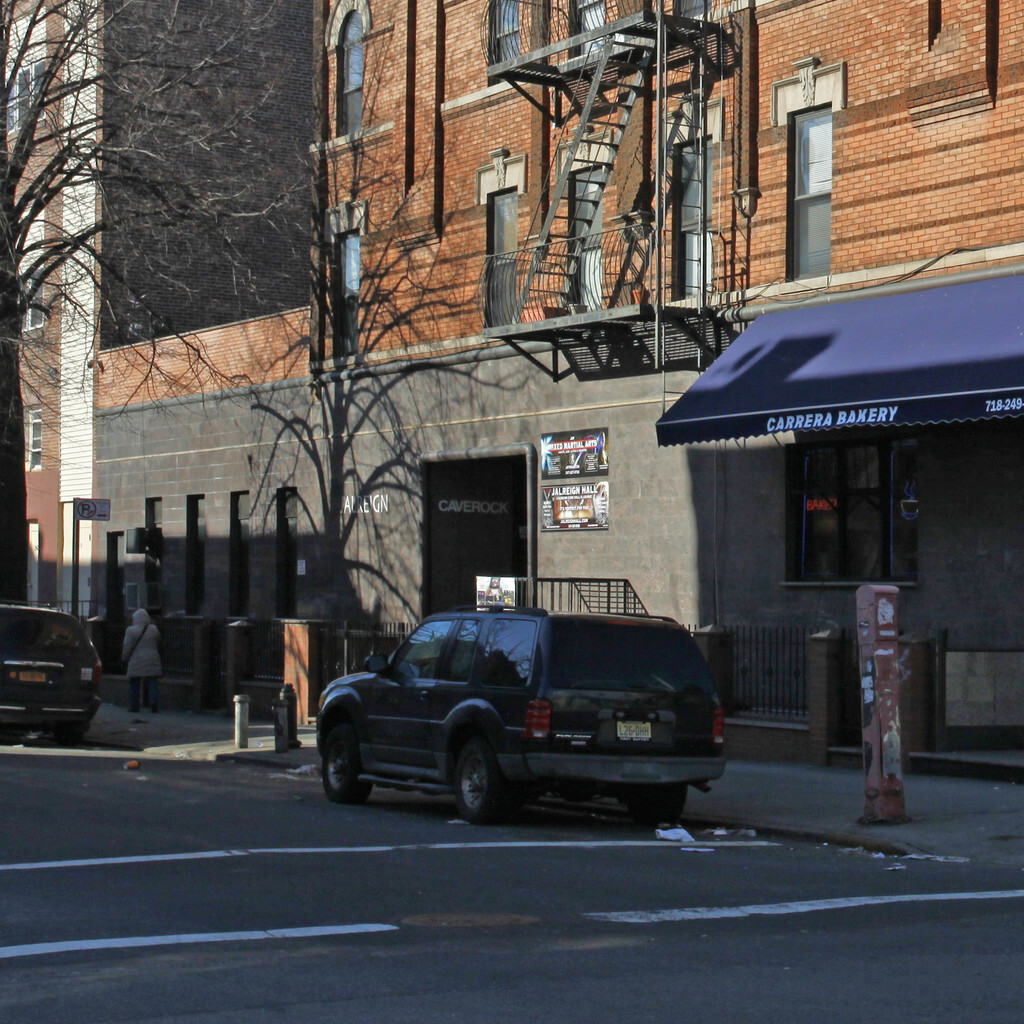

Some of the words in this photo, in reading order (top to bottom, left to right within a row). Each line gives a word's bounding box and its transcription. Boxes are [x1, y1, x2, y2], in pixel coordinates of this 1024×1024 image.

[766, 412, 832, 432] CARRERA
[836, 406, 899, 426] BAKERY
[551, 486, 580, 496] JALREIGN
[582, 485, 598, 493] HALL
[438, 498, 509, 514] CAVEROCK
